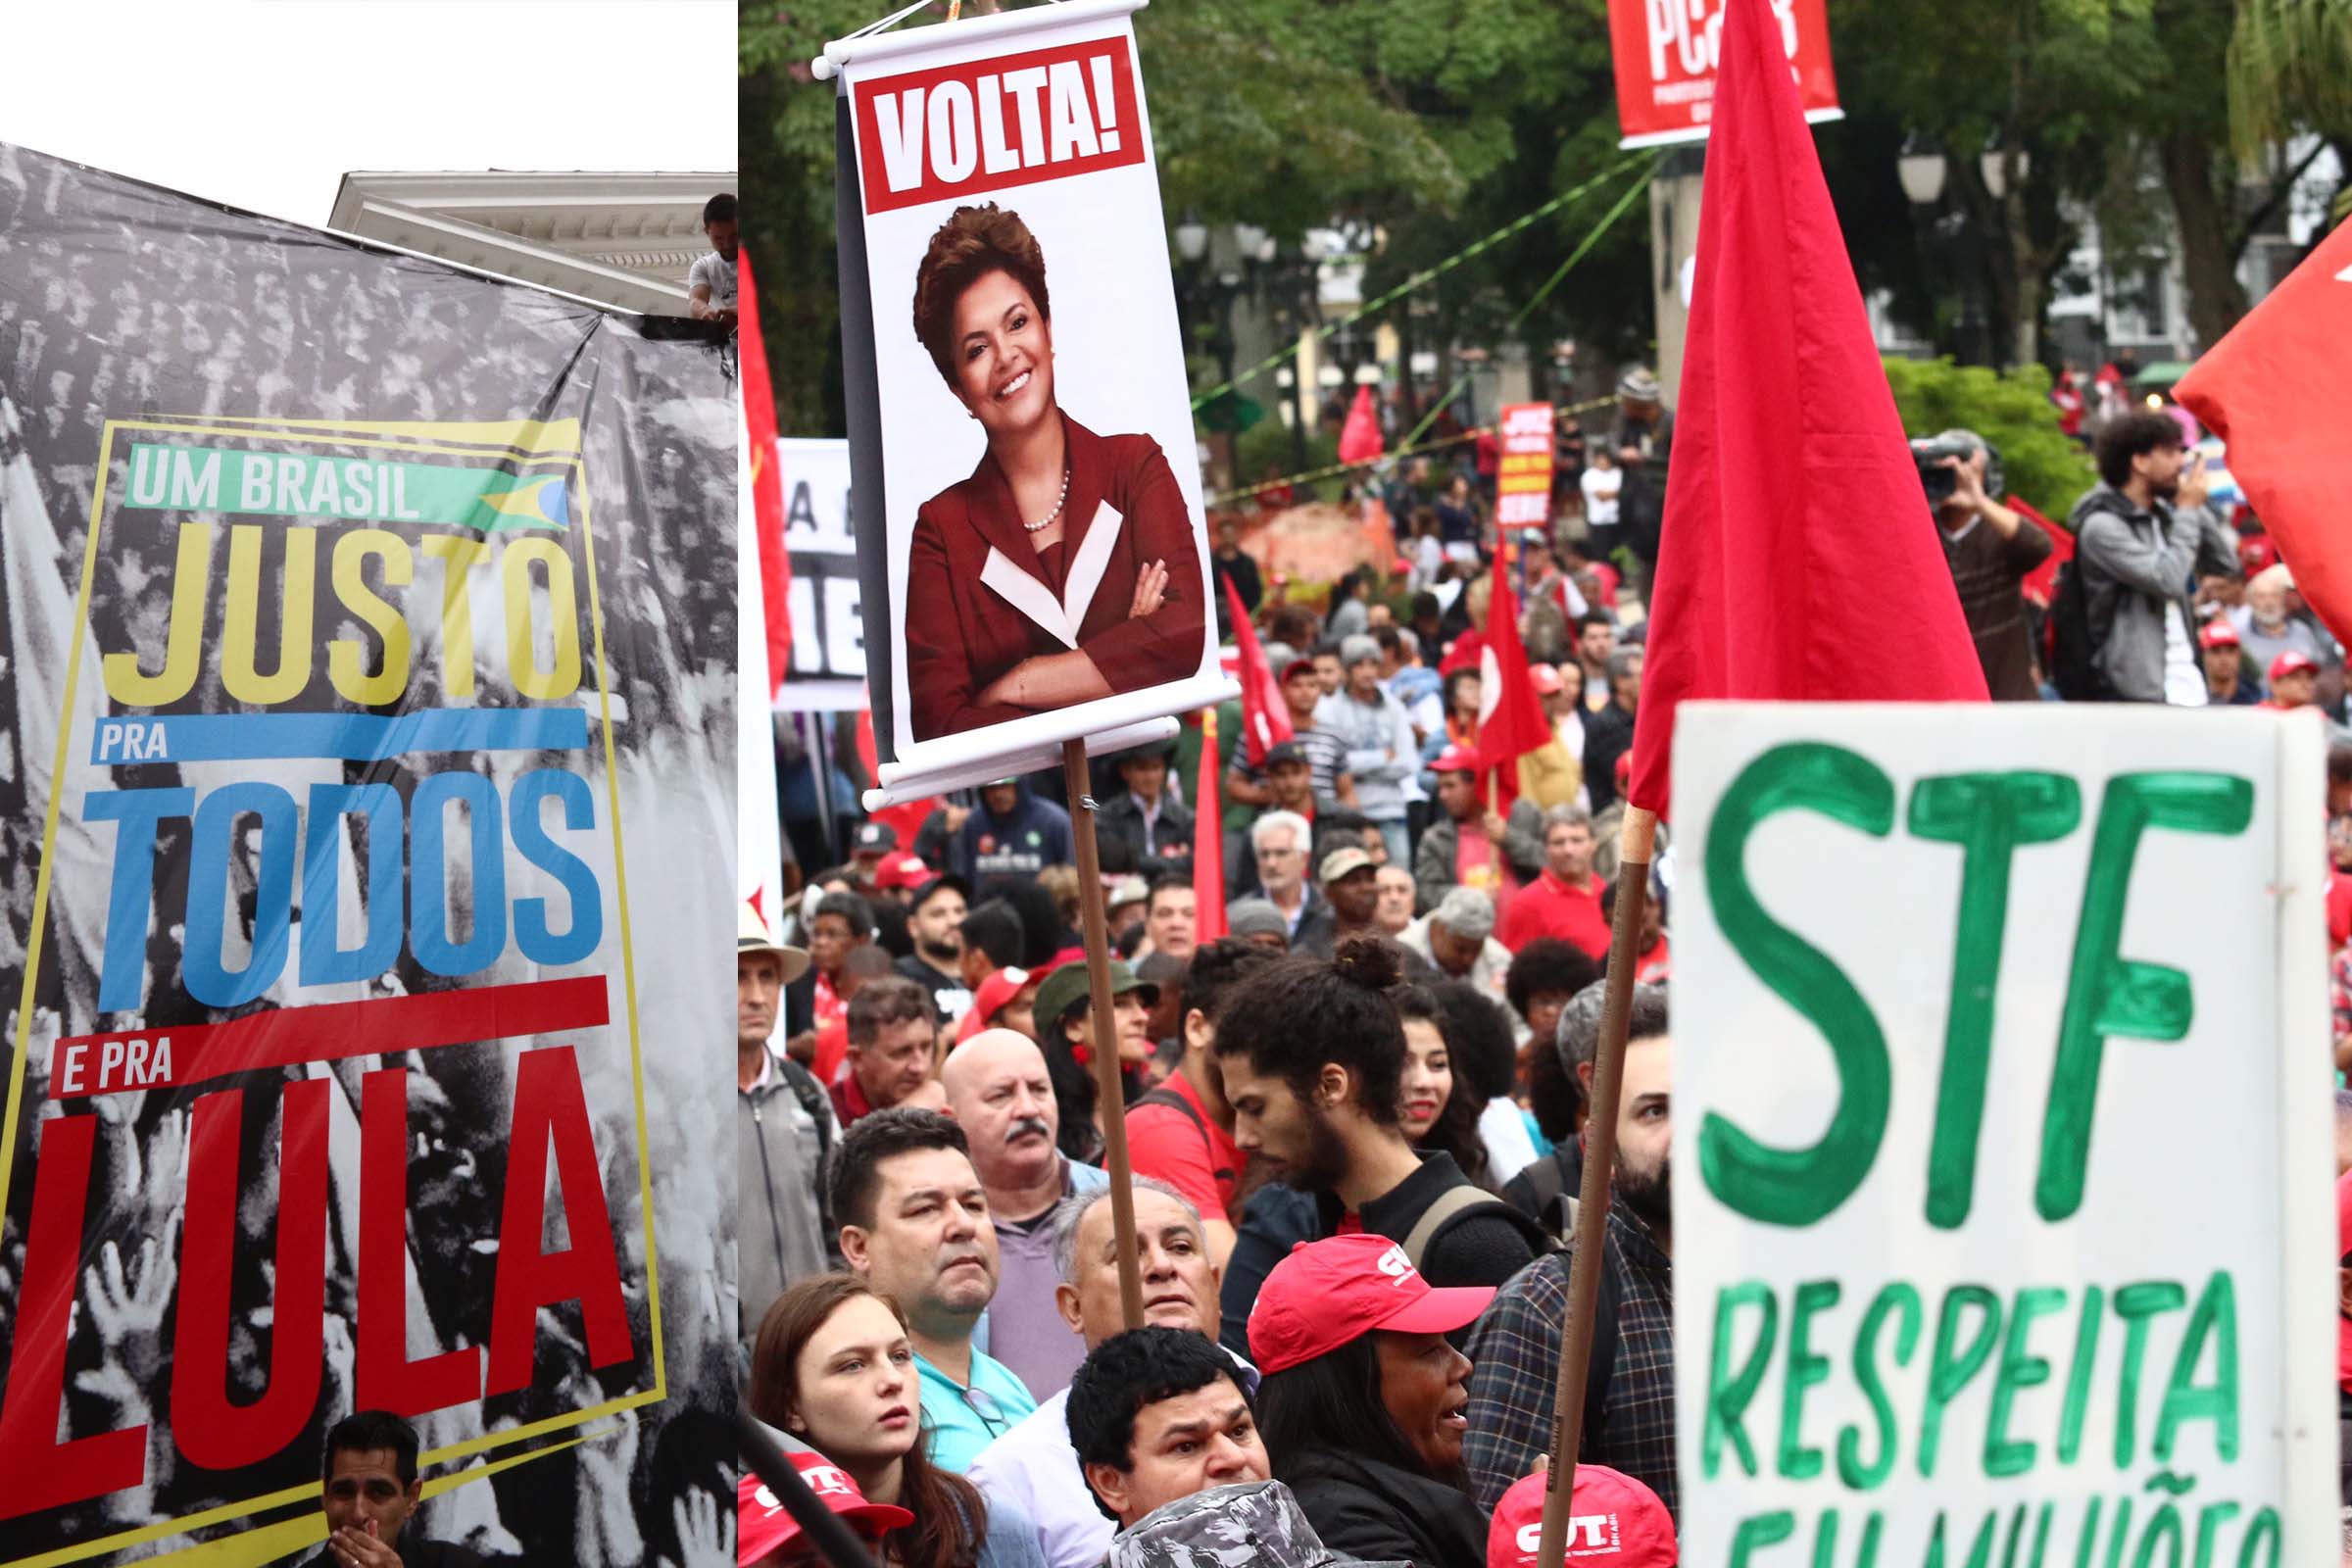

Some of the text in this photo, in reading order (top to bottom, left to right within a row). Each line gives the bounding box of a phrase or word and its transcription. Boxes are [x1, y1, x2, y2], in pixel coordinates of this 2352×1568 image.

[873, 55, 1120, 193] VOLTA!
[132, 448, 420, 518] UM BRASIL
[103, 522, 582, 707] JUSTO
[99, 722, 168, 760] PRA
[82, 769, 604, 1012] TODOS
[62, 1037, 172, 1093] E PRA
[1698, 740, 2254, 1229] STF
[0, 1046, 634, 1521] LULA
[1701, 1270, 2239, 1491] RESPEITA
